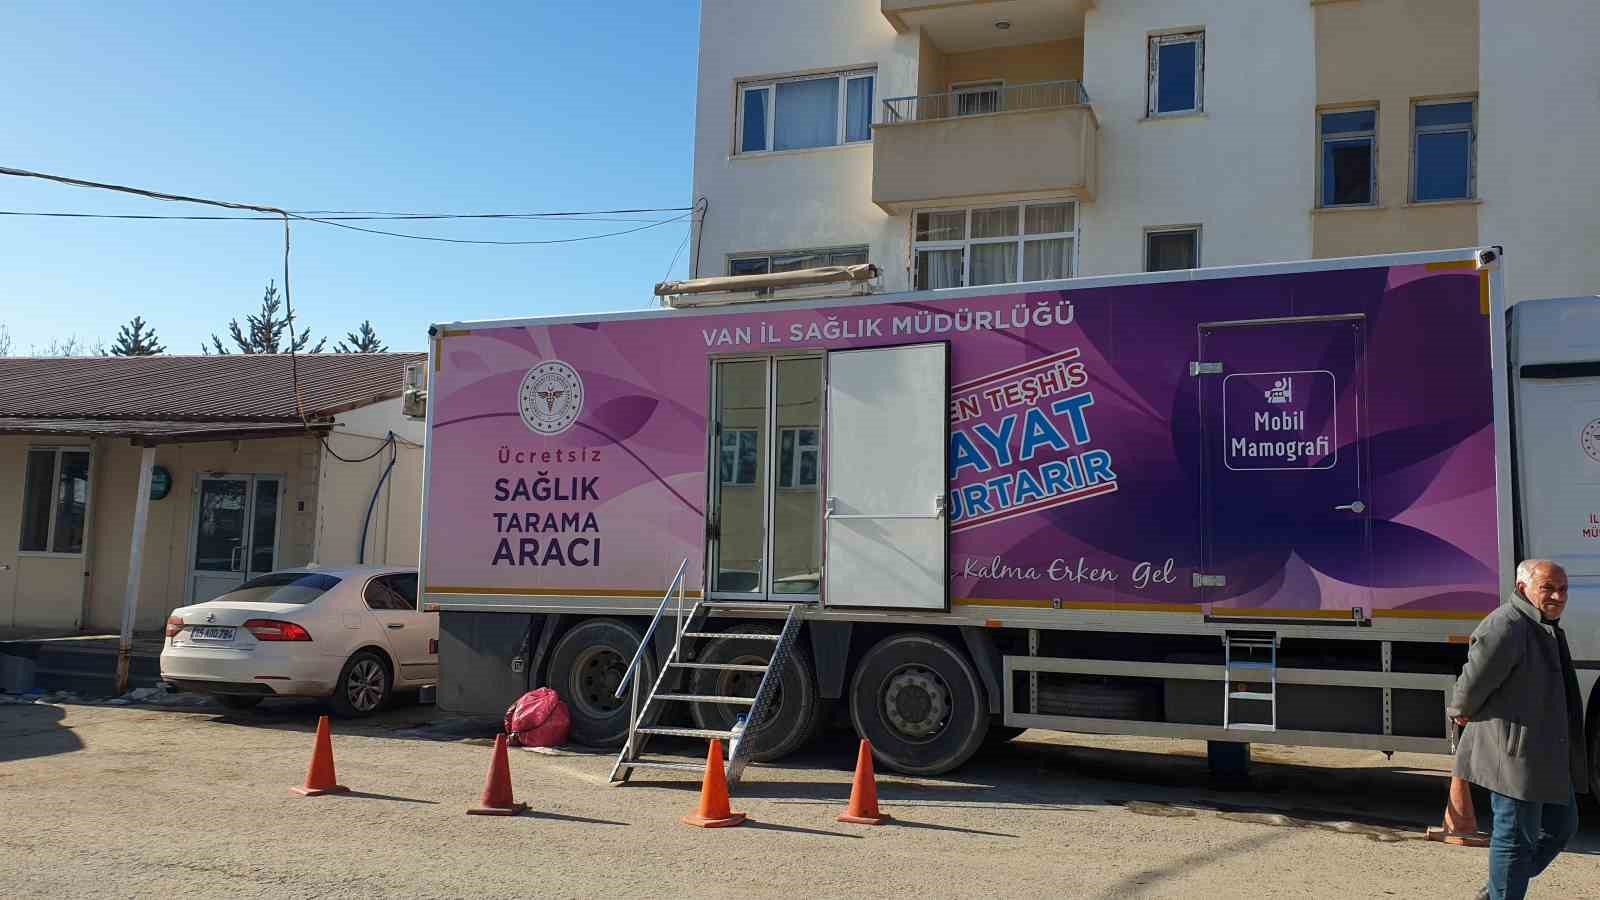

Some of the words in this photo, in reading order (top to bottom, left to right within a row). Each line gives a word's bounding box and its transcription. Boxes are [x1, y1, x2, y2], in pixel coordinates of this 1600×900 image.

[702, 326, 752, 348] VAN
[760, 320, 781, 345] İL
[789, 313, 883, 342] SAĞLIK
[892, 299, 1075, 336] MÜDÜRLÜĞÜ
[952, 395, 981, 423] EN
[984, 362, 1088, 408] TEŞHİS
[951, 391, 1094, 481] AYAT
[1254, 410, 1304, 432] Mobil
[498, 445, 601, 464] Ücretsiz
[1231, 436, 1329, 462] Mamografi
[494, 470, 600, 502] SAĞLIK
[951, 449, 1117, 521] URTARIR
[493, 512, 599, 533] TARAMA
[491, 538, 601, 567] ARACI
[963, 555, 1041, 582] Kalma
[1047, 557, 1118, 583] Erken
[1132, 558, 1177, 589] Gel
